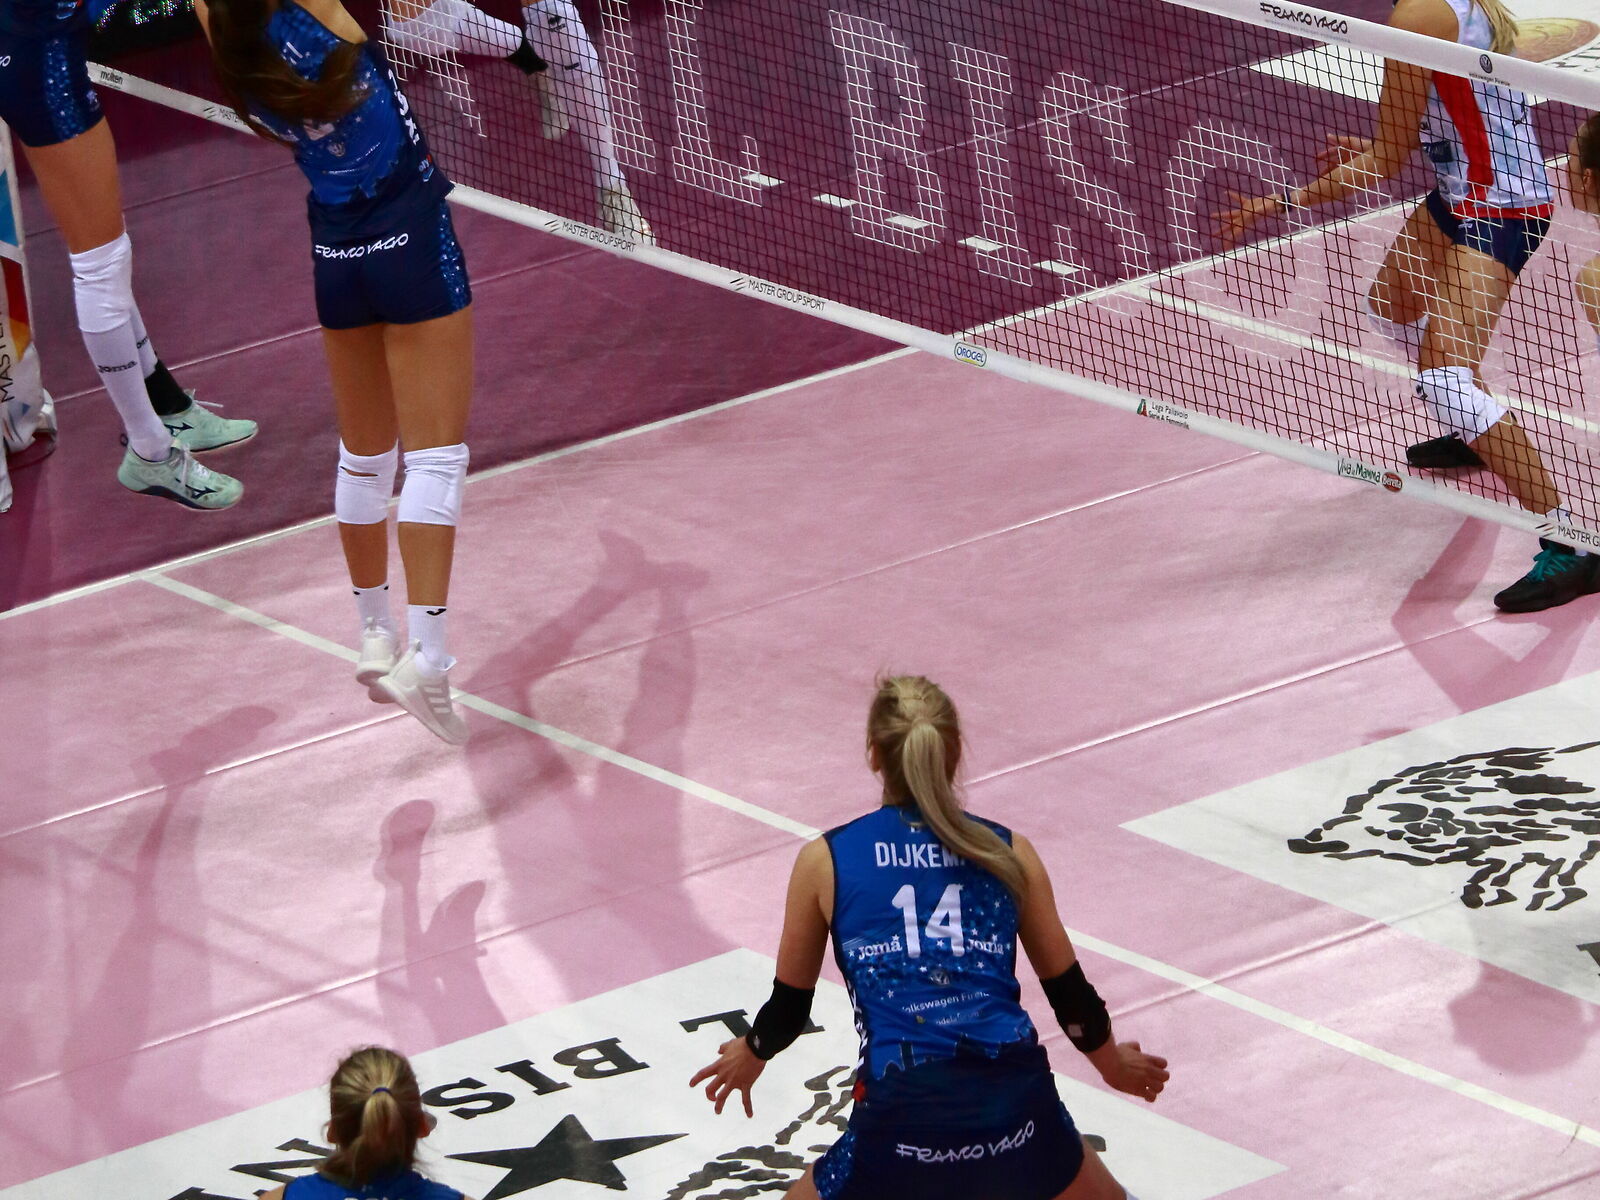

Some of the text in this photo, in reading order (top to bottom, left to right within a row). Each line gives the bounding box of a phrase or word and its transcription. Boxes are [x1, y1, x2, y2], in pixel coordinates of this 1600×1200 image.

[1313, 15, 1348, 34] VAGO
[1557, 524, 1592, 545] MASTER
[874, 841, 966, 868] DIJKEM
[891, 883, 965, 959] 14
[902, 994, 960, 1014] olkswagen
